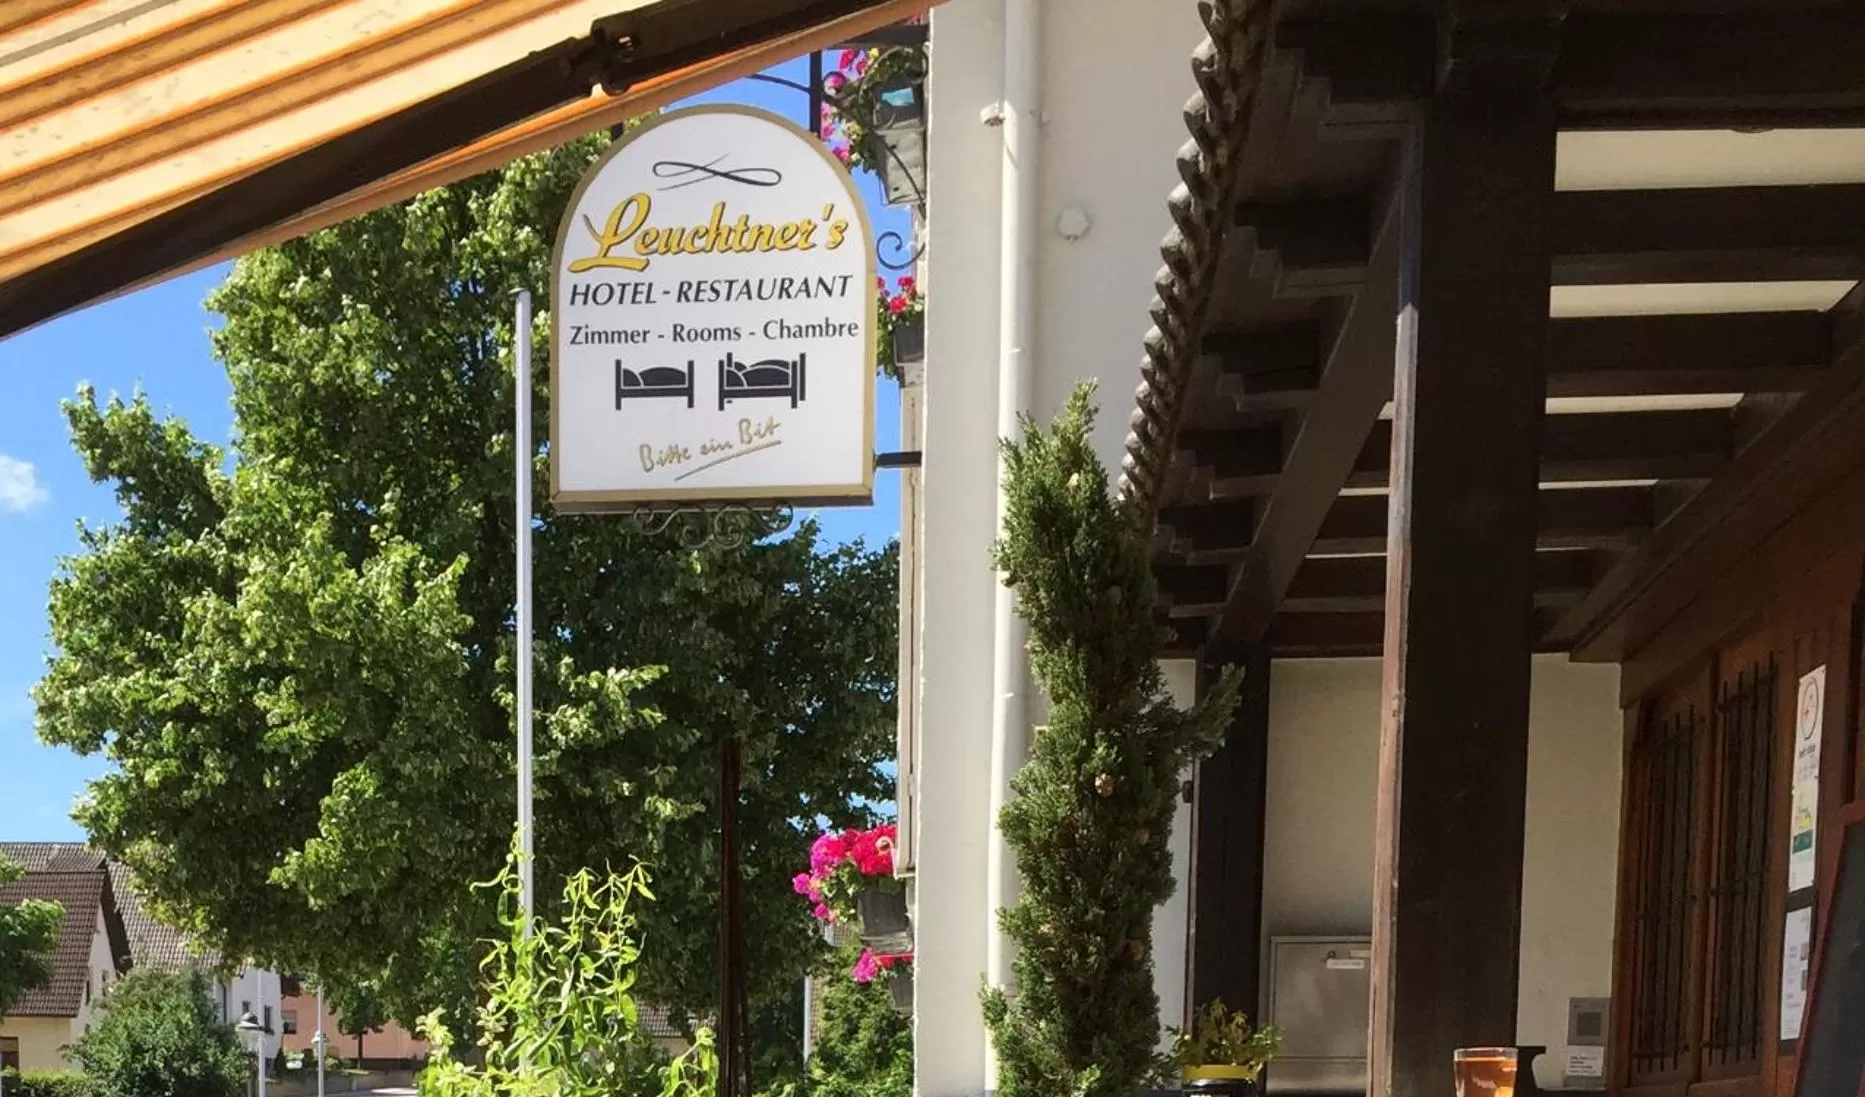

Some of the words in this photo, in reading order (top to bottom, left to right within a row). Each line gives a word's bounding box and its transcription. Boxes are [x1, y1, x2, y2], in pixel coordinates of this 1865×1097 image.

[568, 192, 849, 272] Leuchtner's
[570, 282, 657, 306] HOTEL
[677, 275, 853, 303] RESTAURANT
[569, 324, 650, 346] Zimmer
[672, 322, 742, 343] Rooms
[763, 317, 859, 340] Chambre
[639, 444, 692, 473] Bitte
[700, 438, 733, 455] ein
[738, 416, 781, 445] Bit
